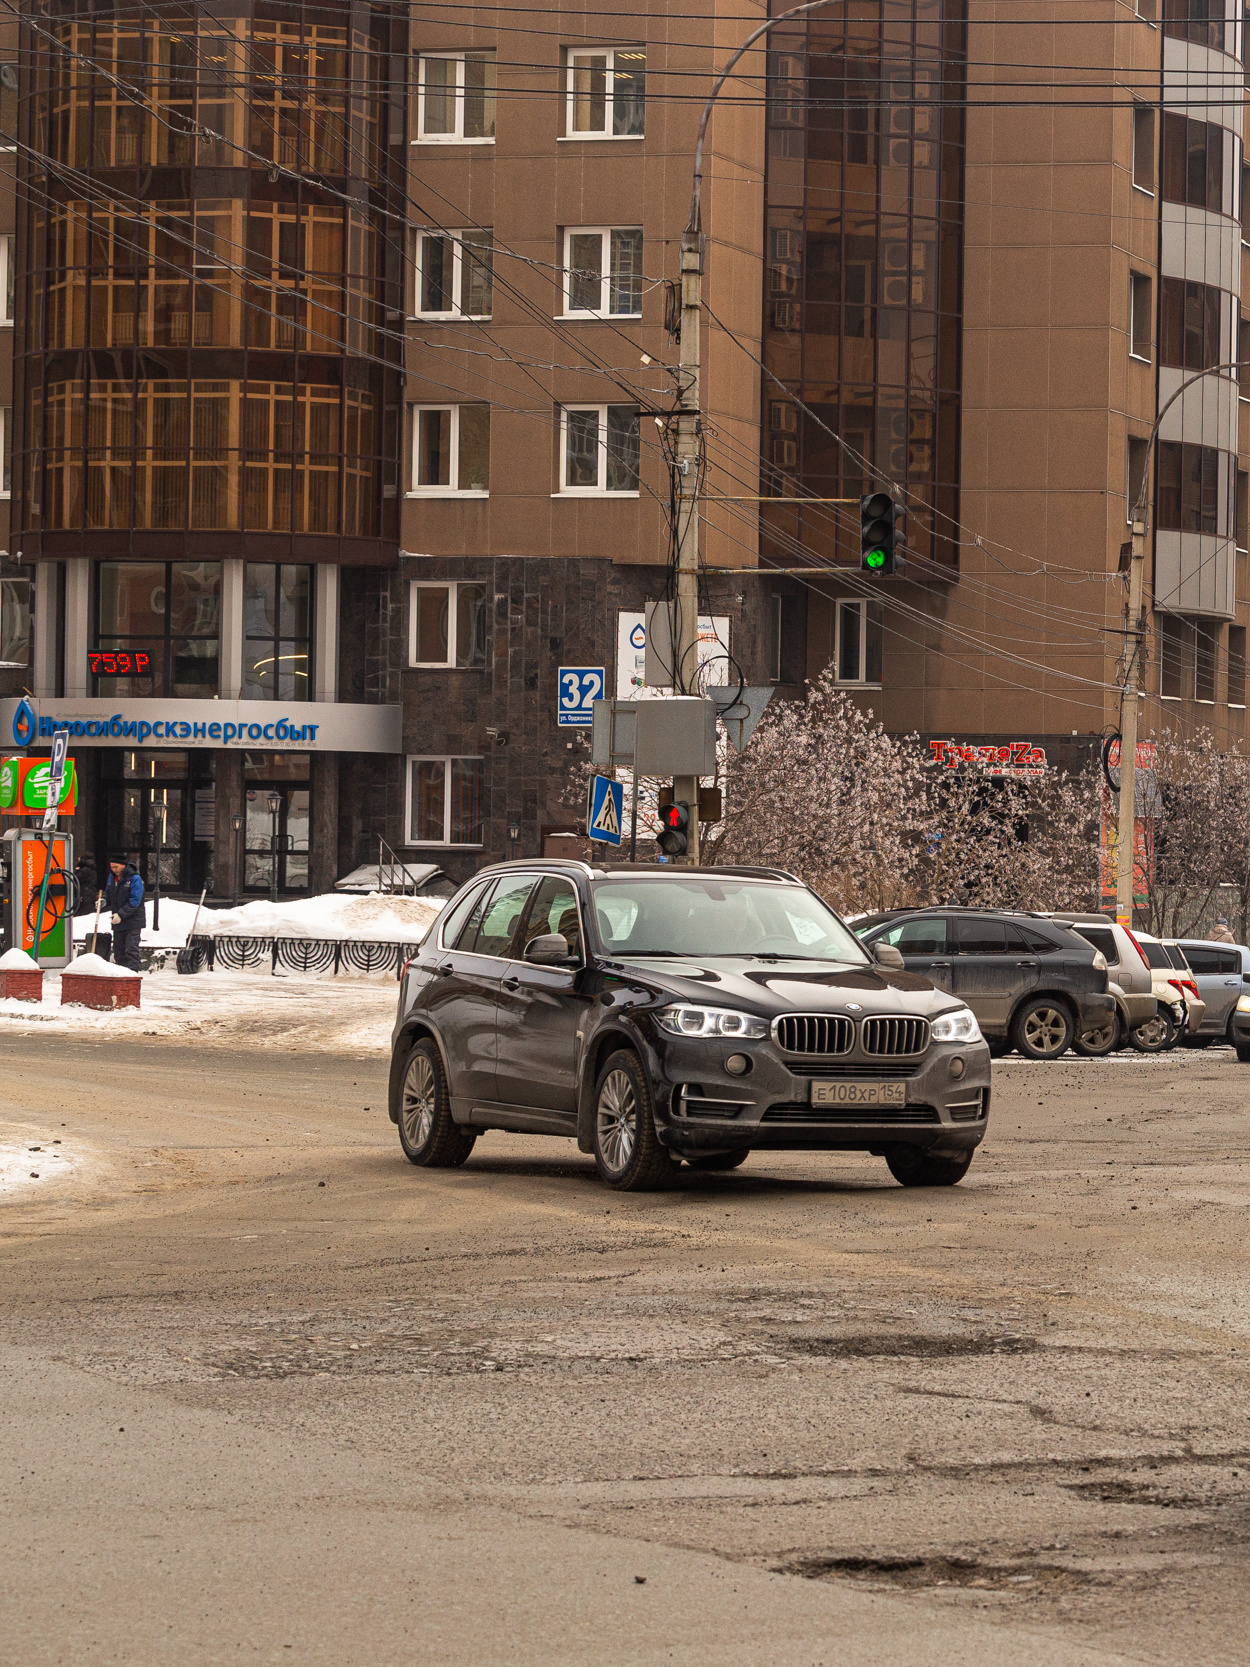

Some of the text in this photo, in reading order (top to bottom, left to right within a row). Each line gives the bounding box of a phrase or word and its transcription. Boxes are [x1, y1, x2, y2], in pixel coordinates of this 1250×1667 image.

[88, 653, 131, 673] 759
[562, 673, 601, 708] 32
[39, 714, 319, 744] Новосибирскэнергосбыт
[817, 1085, 902, 1101] Е108ХР 154
